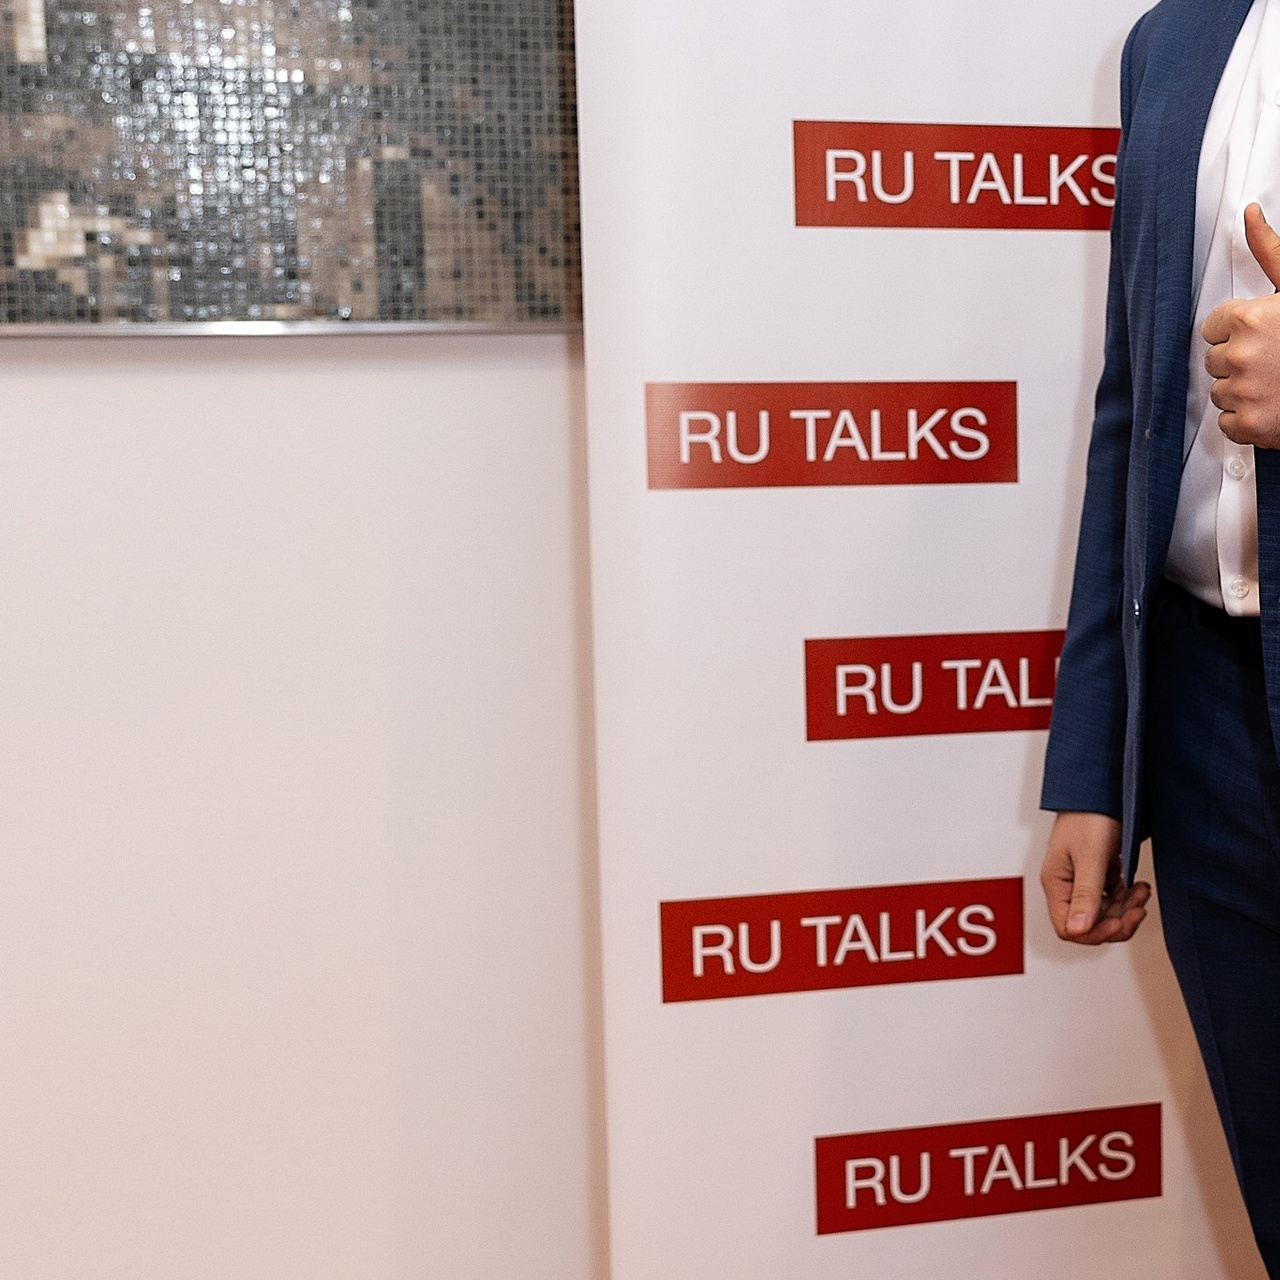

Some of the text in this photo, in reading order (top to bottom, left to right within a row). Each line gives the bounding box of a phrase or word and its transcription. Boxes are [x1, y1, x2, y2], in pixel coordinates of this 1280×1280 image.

[825, 148, 1118, 208] RU TALKS
[679, 407, 990, 465] RU TALKS
[835, 655, 1061, 716] RU TAL
[692, 904, 997, 977] RU TALKS
[845, 1131, 1135, 1209] RU TALKS
